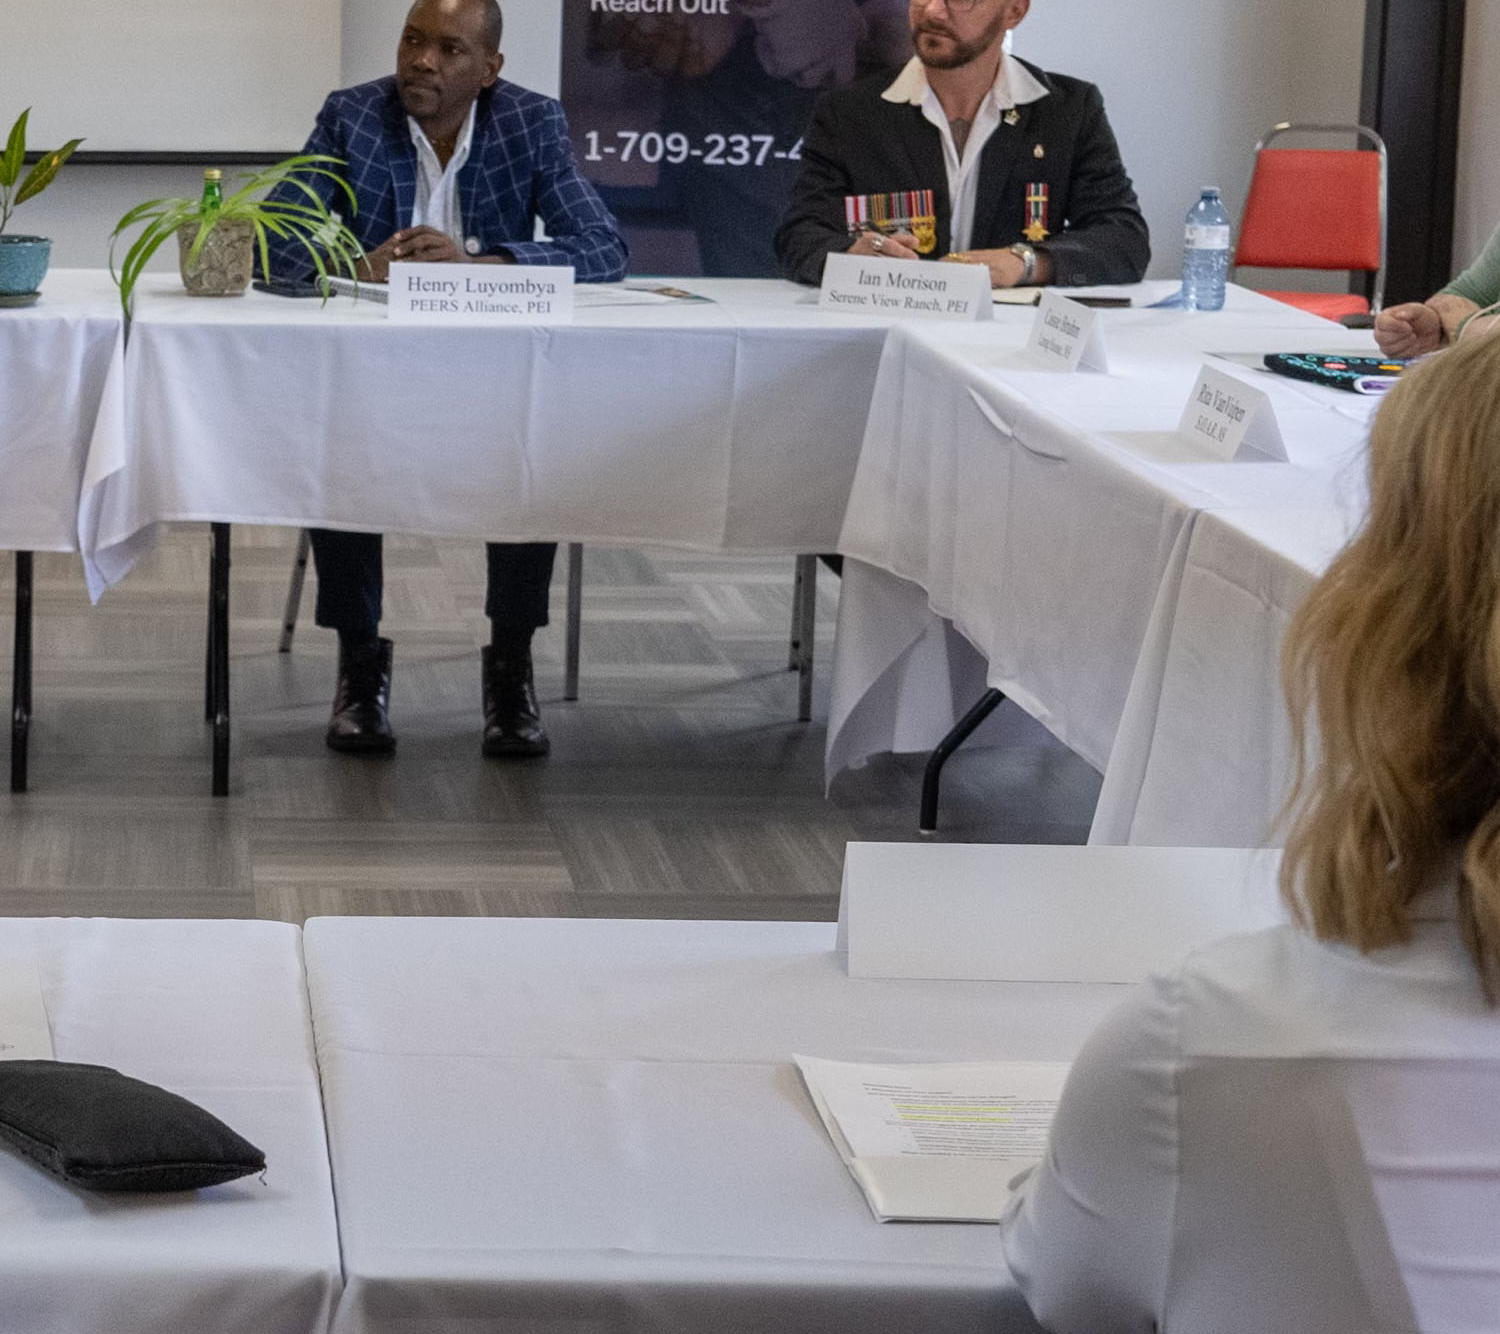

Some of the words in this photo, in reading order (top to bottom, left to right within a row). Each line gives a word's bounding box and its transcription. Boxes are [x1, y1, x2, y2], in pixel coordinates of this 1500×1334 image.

[584, 130, 805, 166] 1-709-237-4
[407, 276, 459, 297] Henry
[465, 278, 556, 298] Luyombya
[858, 269, 881, 286] Ian
[886, 272, 947, 292] Morison
[410, 299, 458, 313] PEERS
[463, 300, 522, 314] Alliance,
[527, 301, 551, 314] PEI
[828, 290, 868, 305] Serene
[871, 293, 900, 308] View
[904, 296, 943, 312] Ranch,
[946, 300, 969, 314] PEI
